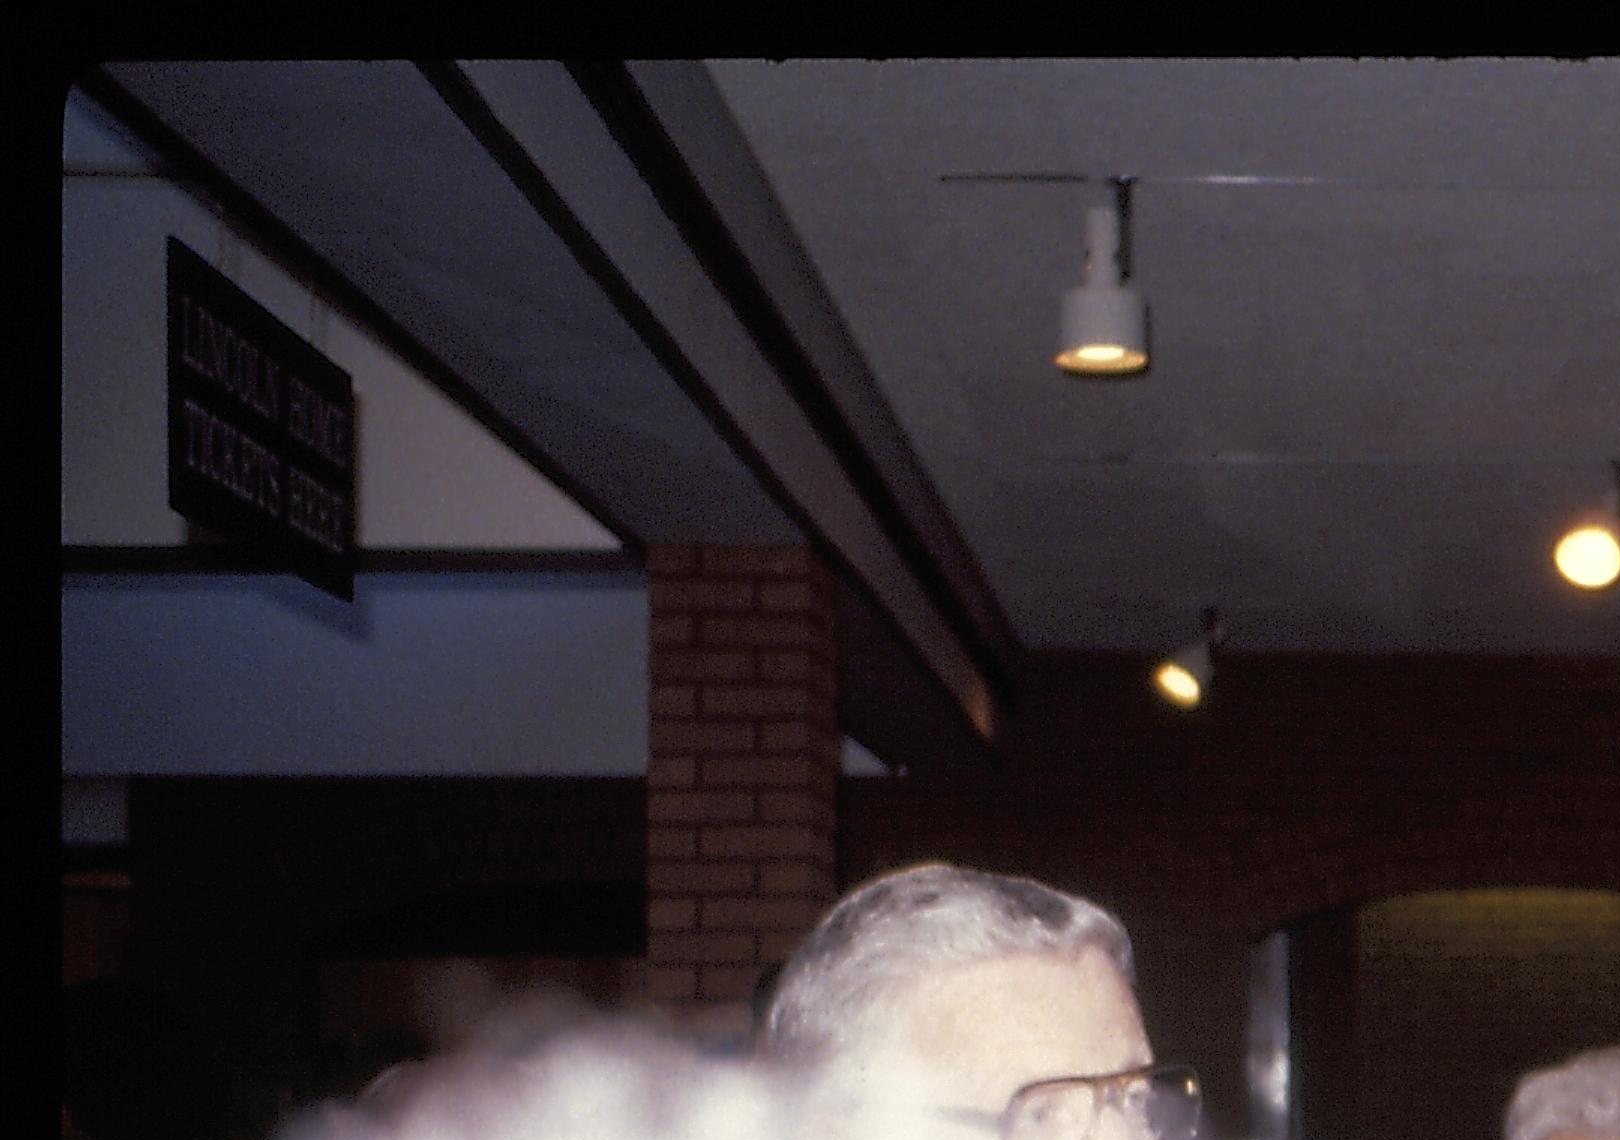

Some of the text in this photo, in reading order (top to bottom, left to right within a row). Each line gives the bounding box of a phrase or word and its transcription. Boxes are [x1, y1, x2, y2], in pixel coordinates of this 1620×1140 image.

[180, 294, 349, 471] LINCOLN HOME
[182, 397, 346, 556] TICKETS HERE
